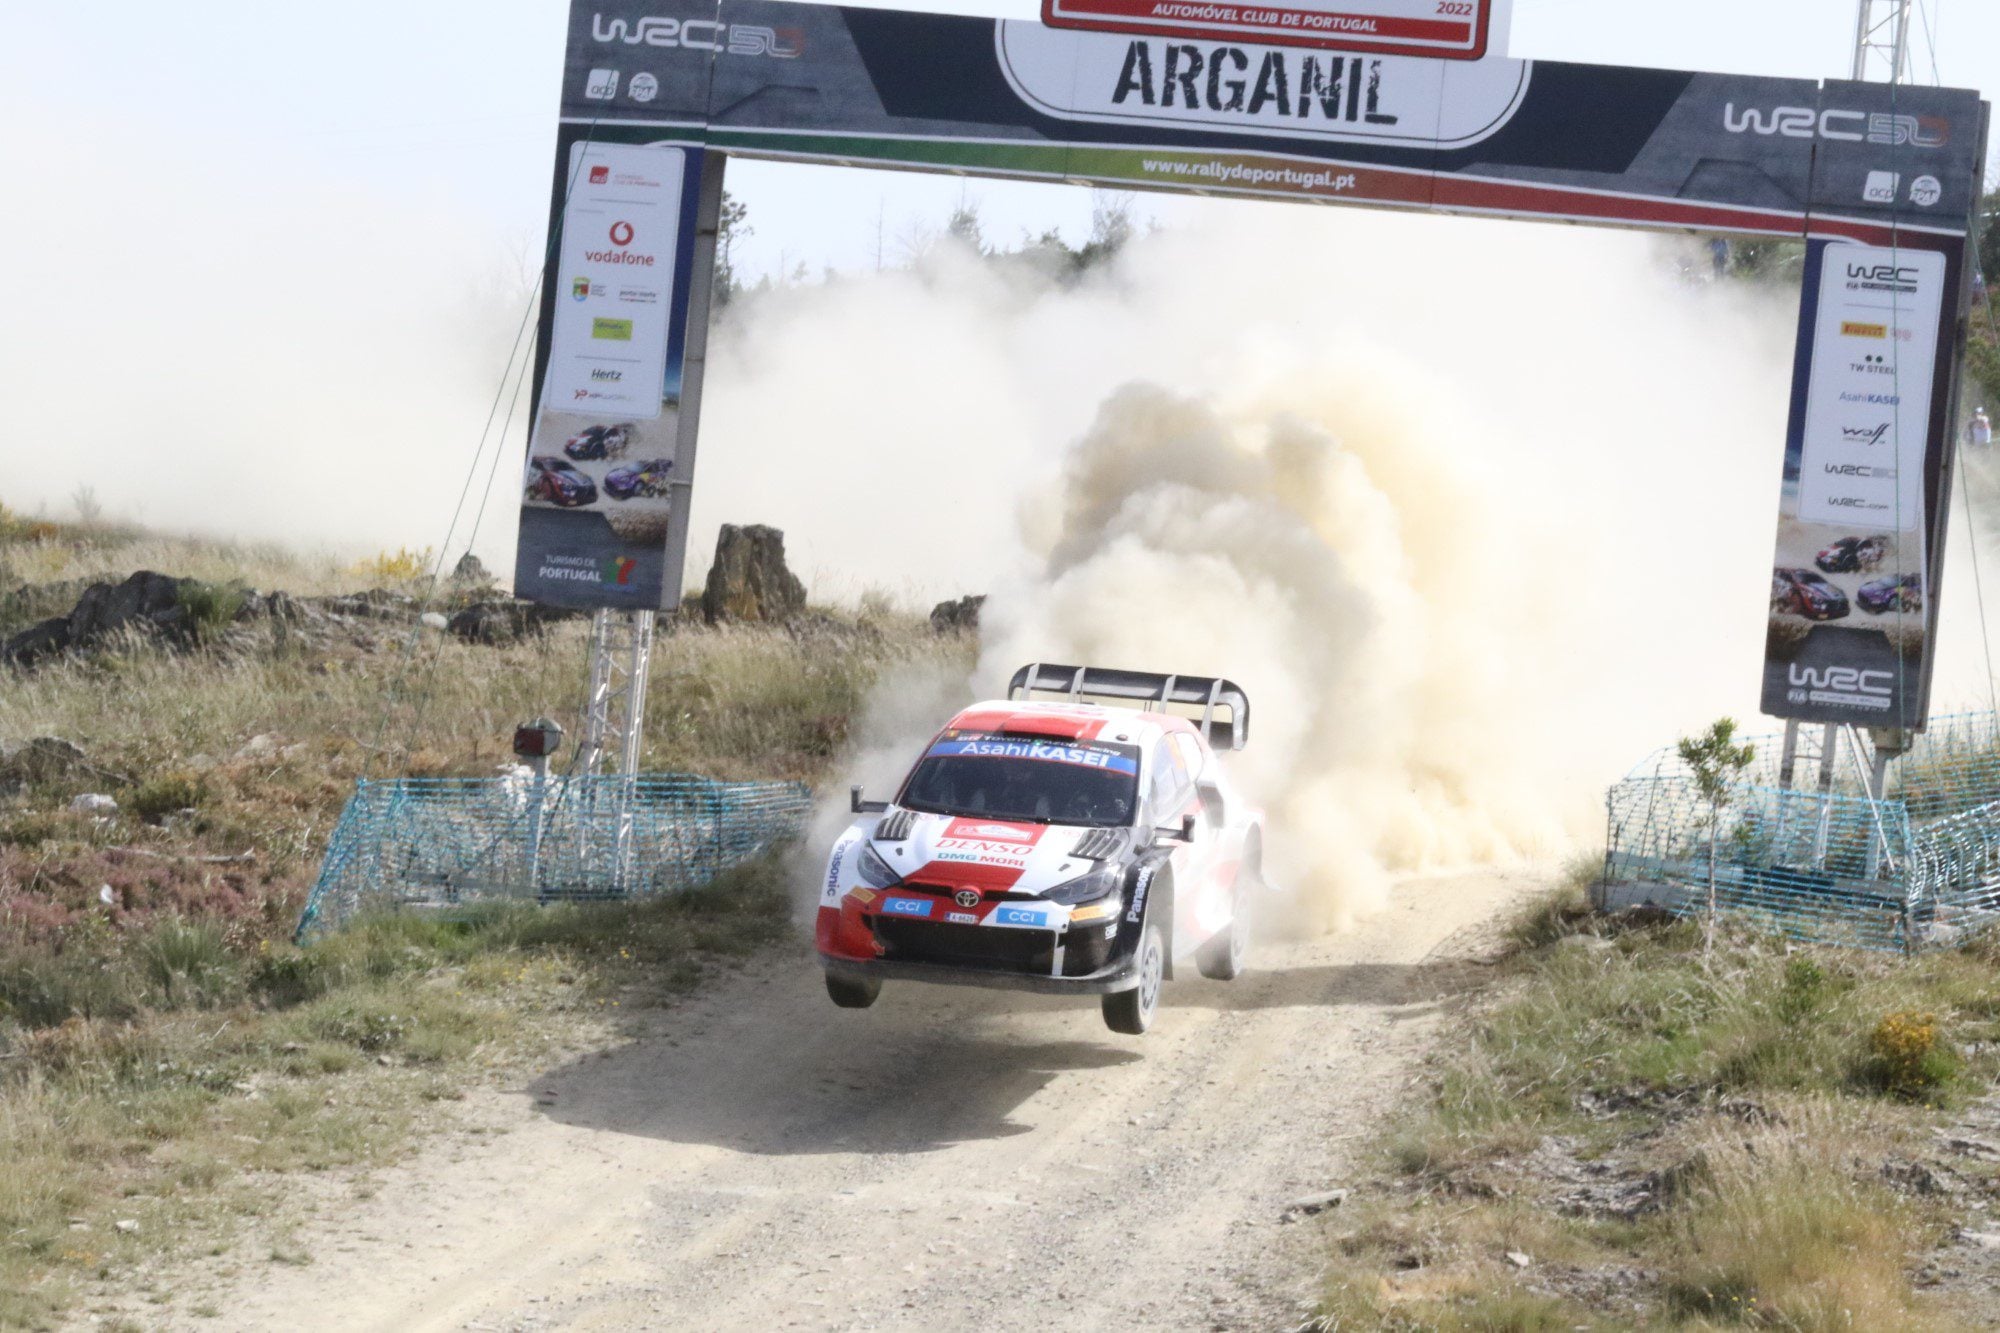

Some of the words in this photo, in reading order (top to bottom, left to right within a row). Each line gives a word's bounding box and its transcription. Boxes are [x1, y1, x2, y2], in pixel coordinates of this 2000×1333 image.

[1436, 1, 1473, 16] 2022
[1152, 3, 1238, 21] AUTOMÓVEL
[1242, 10, 1278, 24] CLUB
[1281, 14, 1301, 25] DE
[1303, 15, 1377, 32] PORTUGAL
[1111, 40, 1398, 125] ARGANIL
[1143, 159, 1355, 189] www.rallydeportugal.pt
[585, 250, 655, 267] vodafone
[1847, 263, 1919, 284] WRC
[591, 368, 622, 380] Hertz
[545, 554, 583, 567] TURISMO
[584, 558, 597, 568] DE
[539, 566, 602, 582] PORTUGAL
[935, 838, 1035, 856] DENSO
[937, 852, 978, 862] DMG
[979, 855, 1026, 867] MORI
[894, 900, 922, 912] CCI
[1008, 911, 1035, 923] CCI
